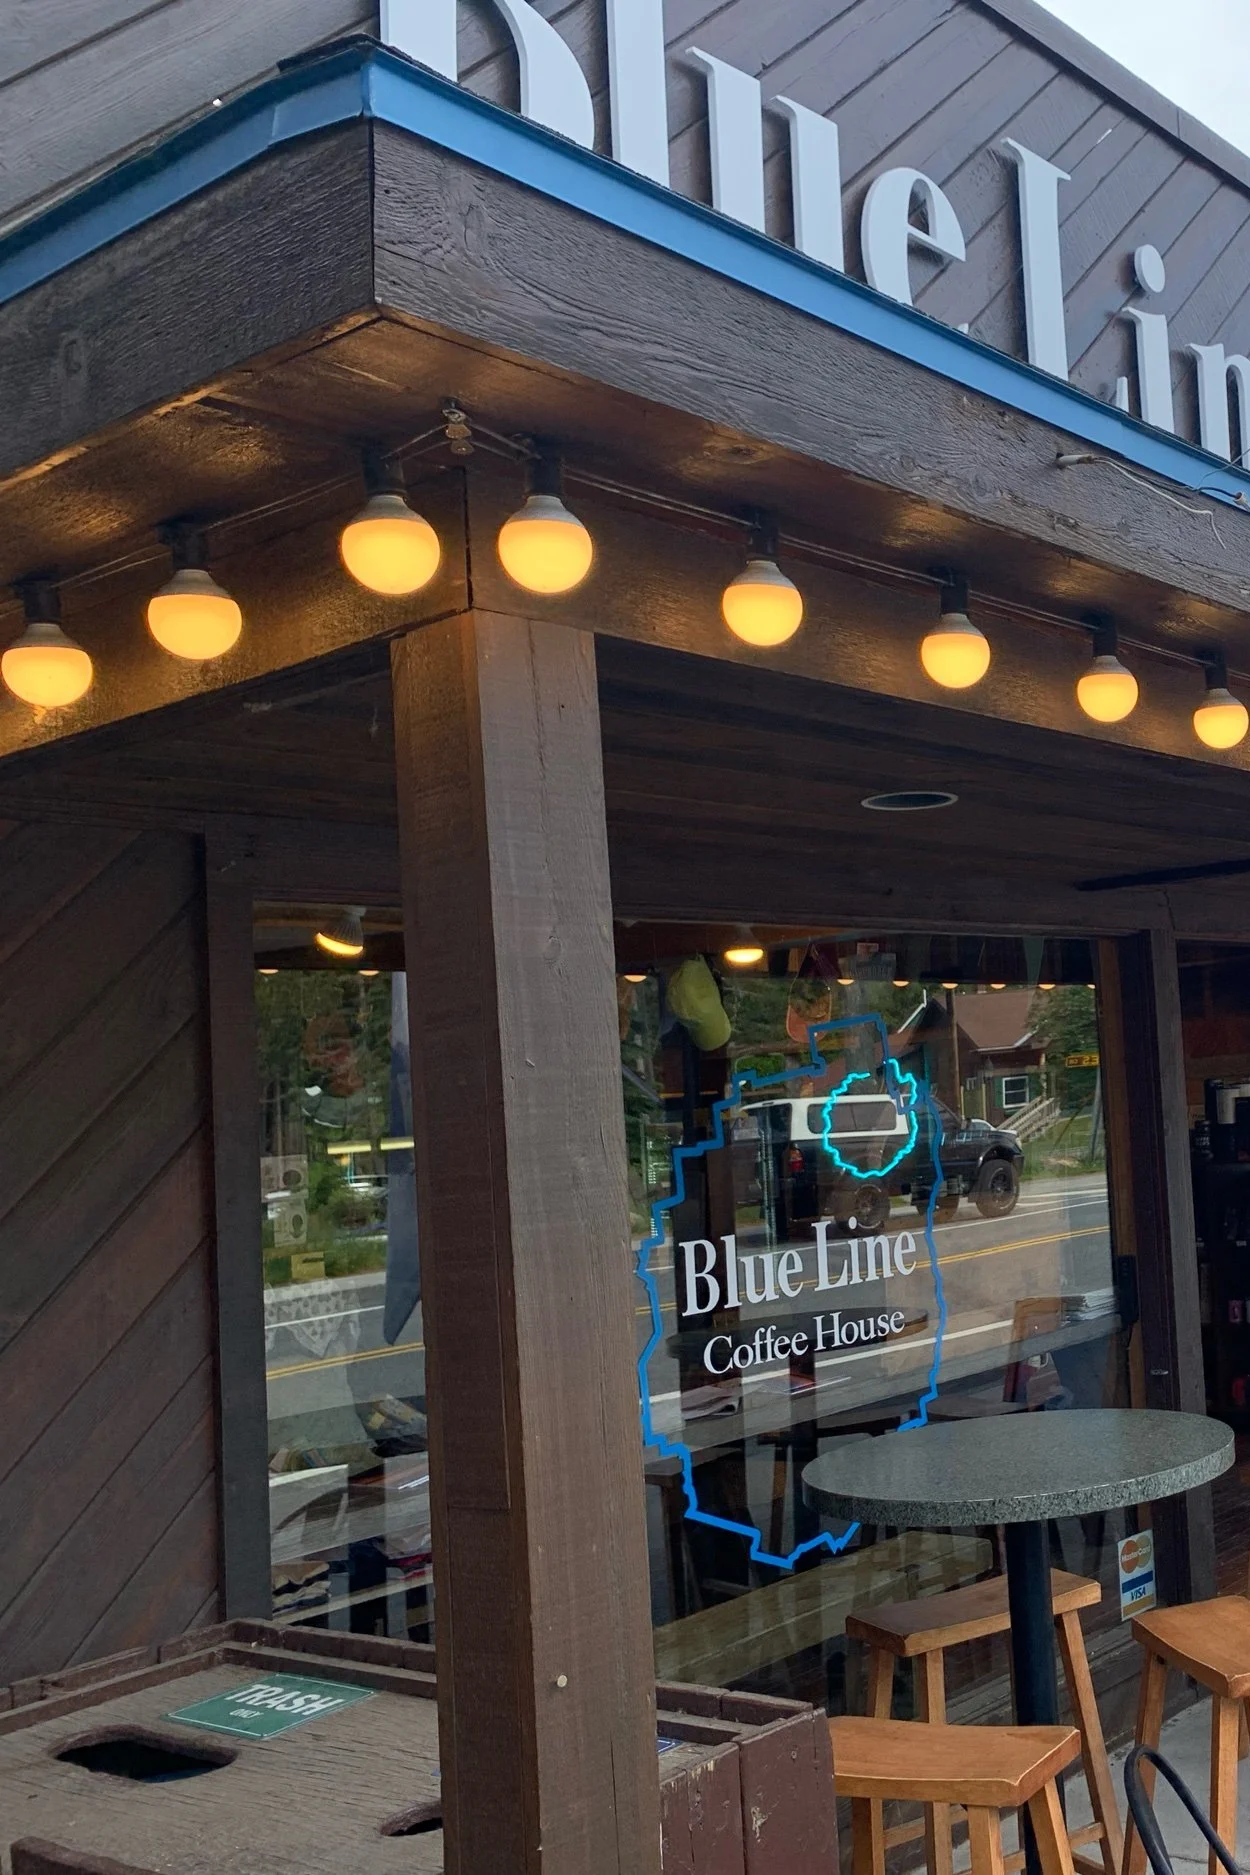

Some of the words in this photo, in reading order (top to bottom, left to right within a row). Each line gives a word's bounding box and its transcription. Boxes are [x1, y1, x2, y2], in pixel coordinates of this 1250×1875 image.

[679, 1234, 803, 1317] Blue
[811, 1216, 917, 1292] Line
[703, 1325, 808, 1375] Coffee
[812, 1311, 905, 1352] House
[1131, 1585, 1146, 1601] VISA
[224, 1683, 345, 1716] TRASH
[229, 1708, 264, 1719] ONLY
